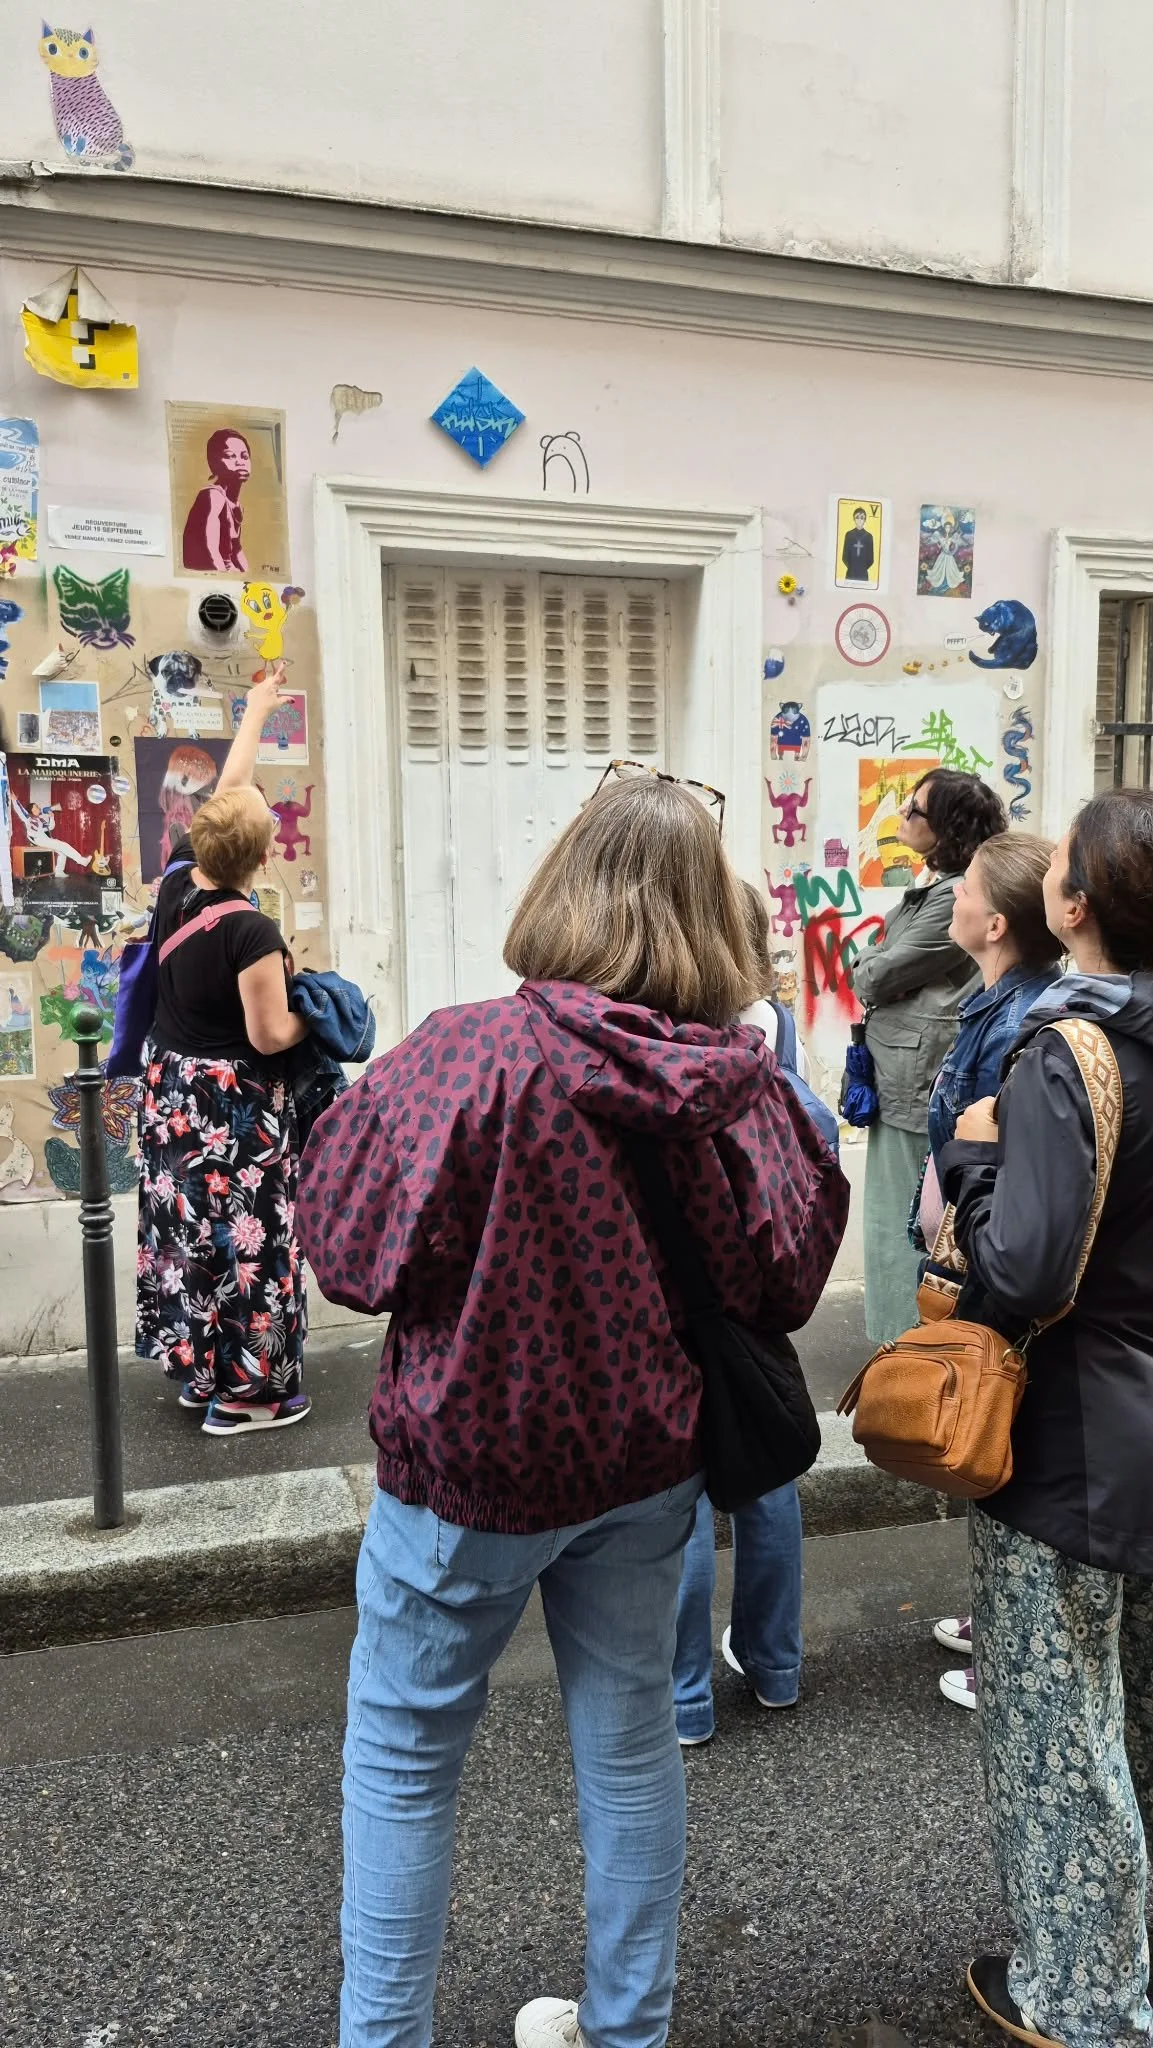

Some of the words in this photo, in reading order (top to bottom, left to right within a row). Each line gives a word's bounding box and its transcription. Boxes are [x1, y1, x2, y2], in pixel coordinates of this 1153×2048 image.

[102, 527, 143, 536] SEPTEMBRE
[35, 757, 80, 768] DMA
[18, 768, 30, 776] LA
[32, 769, 98, 778] MAROQUINERIE
